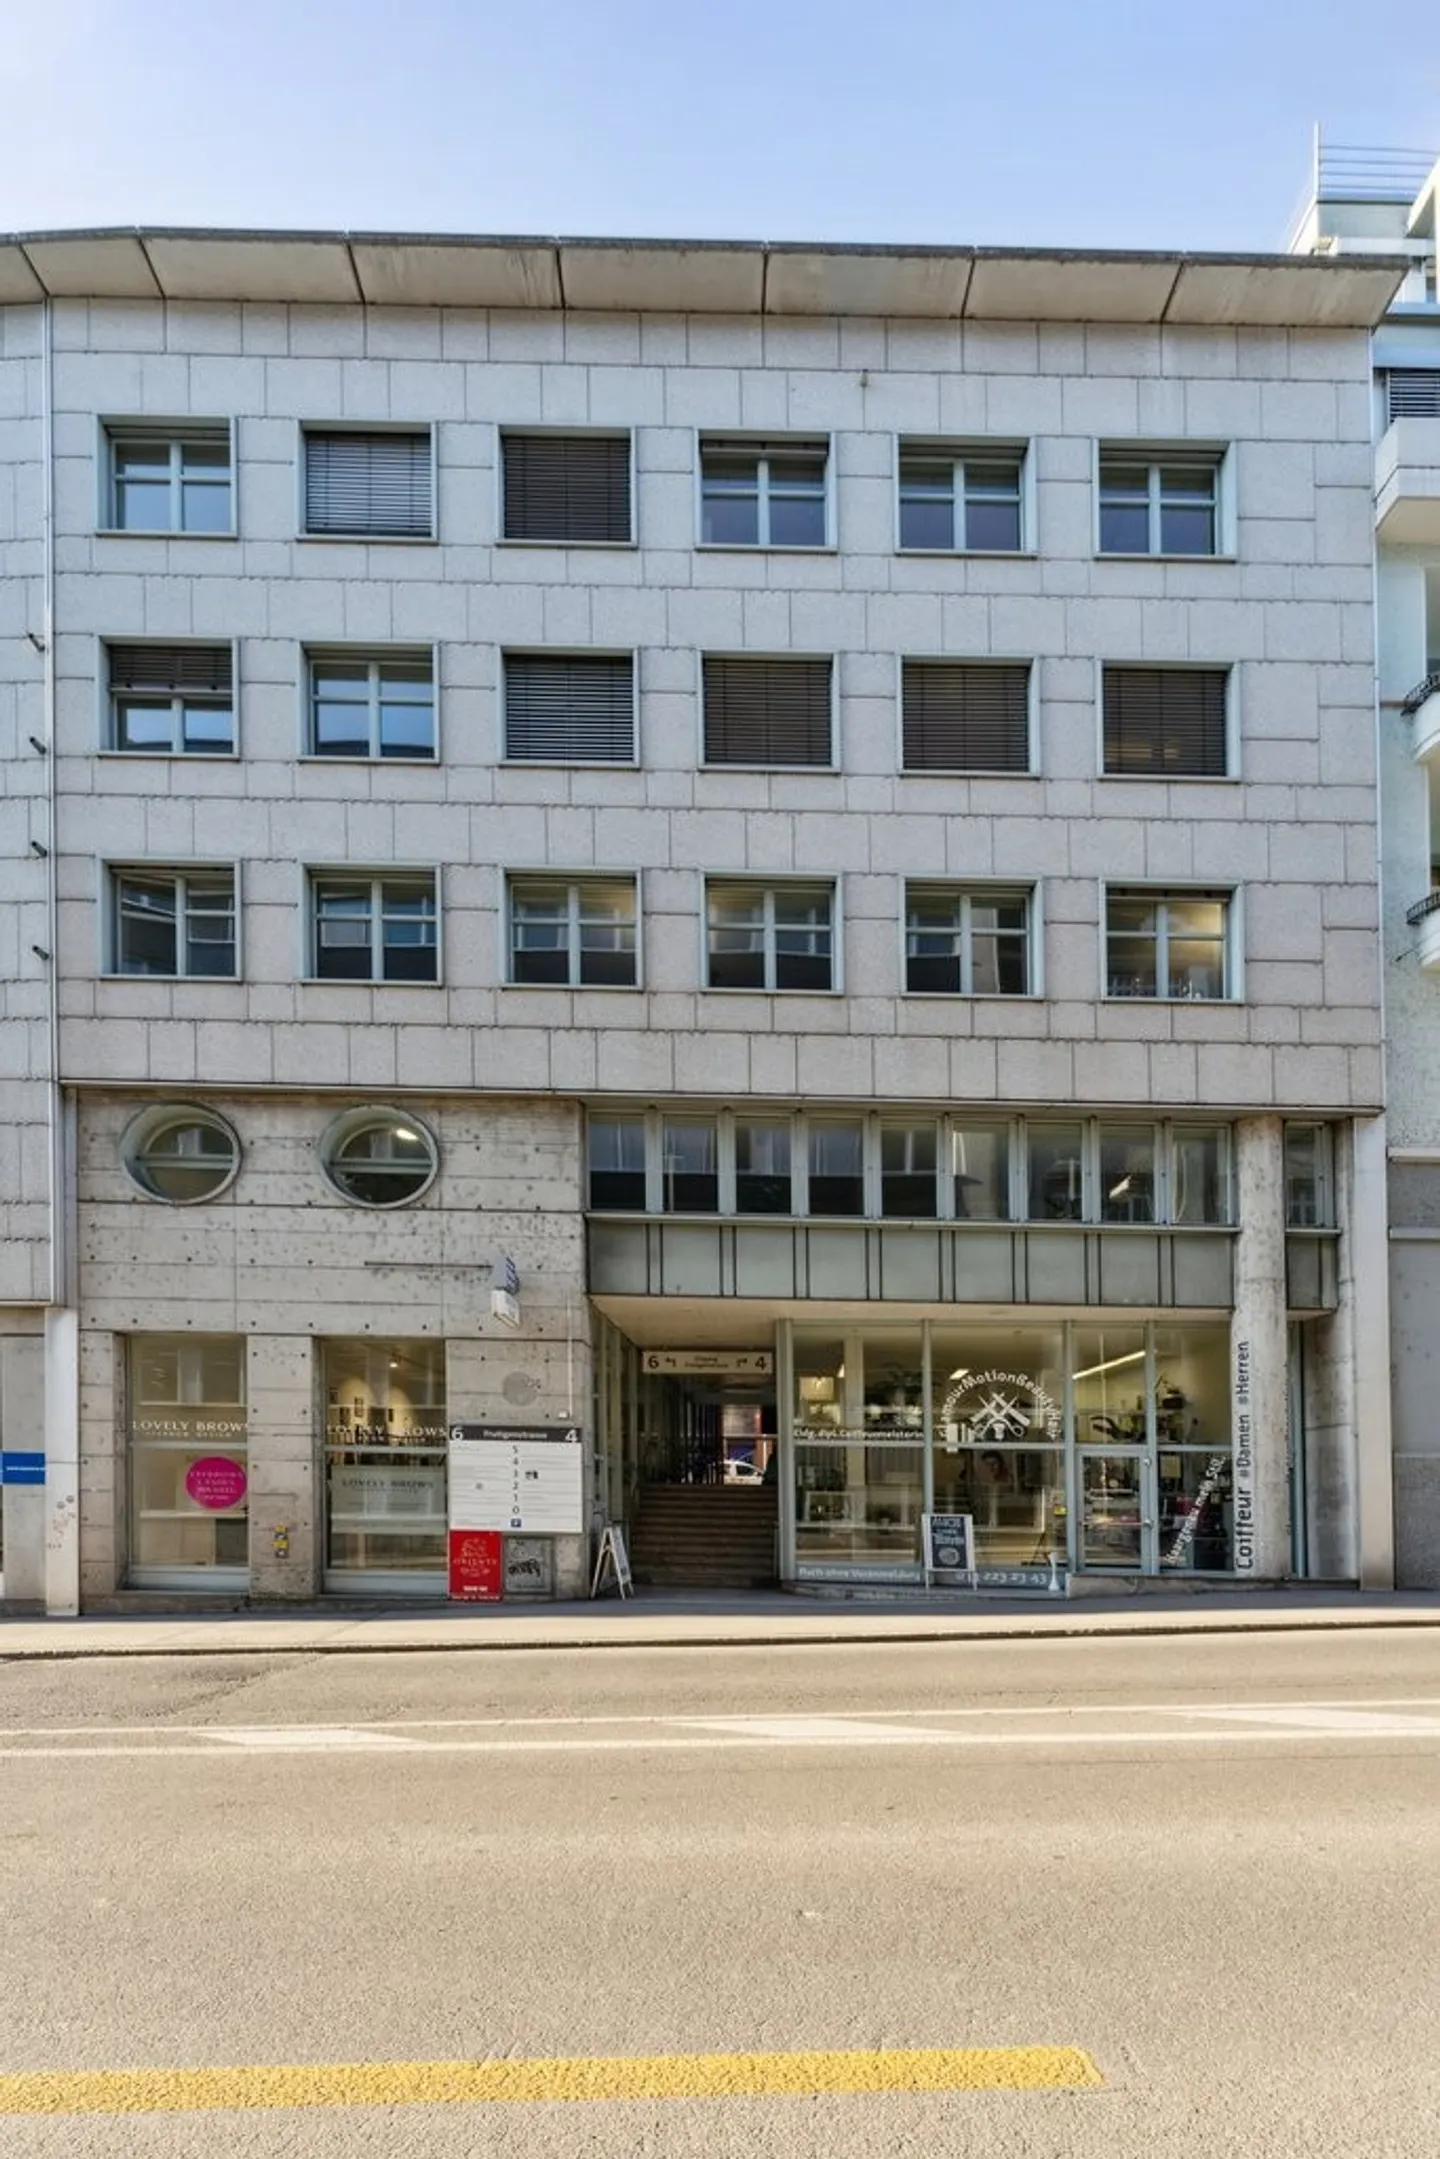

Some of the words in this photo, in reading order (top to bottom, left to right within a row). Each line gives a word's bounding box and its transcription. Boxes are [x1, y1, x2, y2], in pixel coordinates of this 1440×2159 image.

[648, 1355, 659, 1369] 6
[755, 1356, 767, 1370] 4
[132, 1420, 189, 1431] LOVELY
[451, 1426, 464, 1441] 6
[565, 1429, 578, 1443] 4
[1236, 1487, 1254, 1570] Coiffeur
